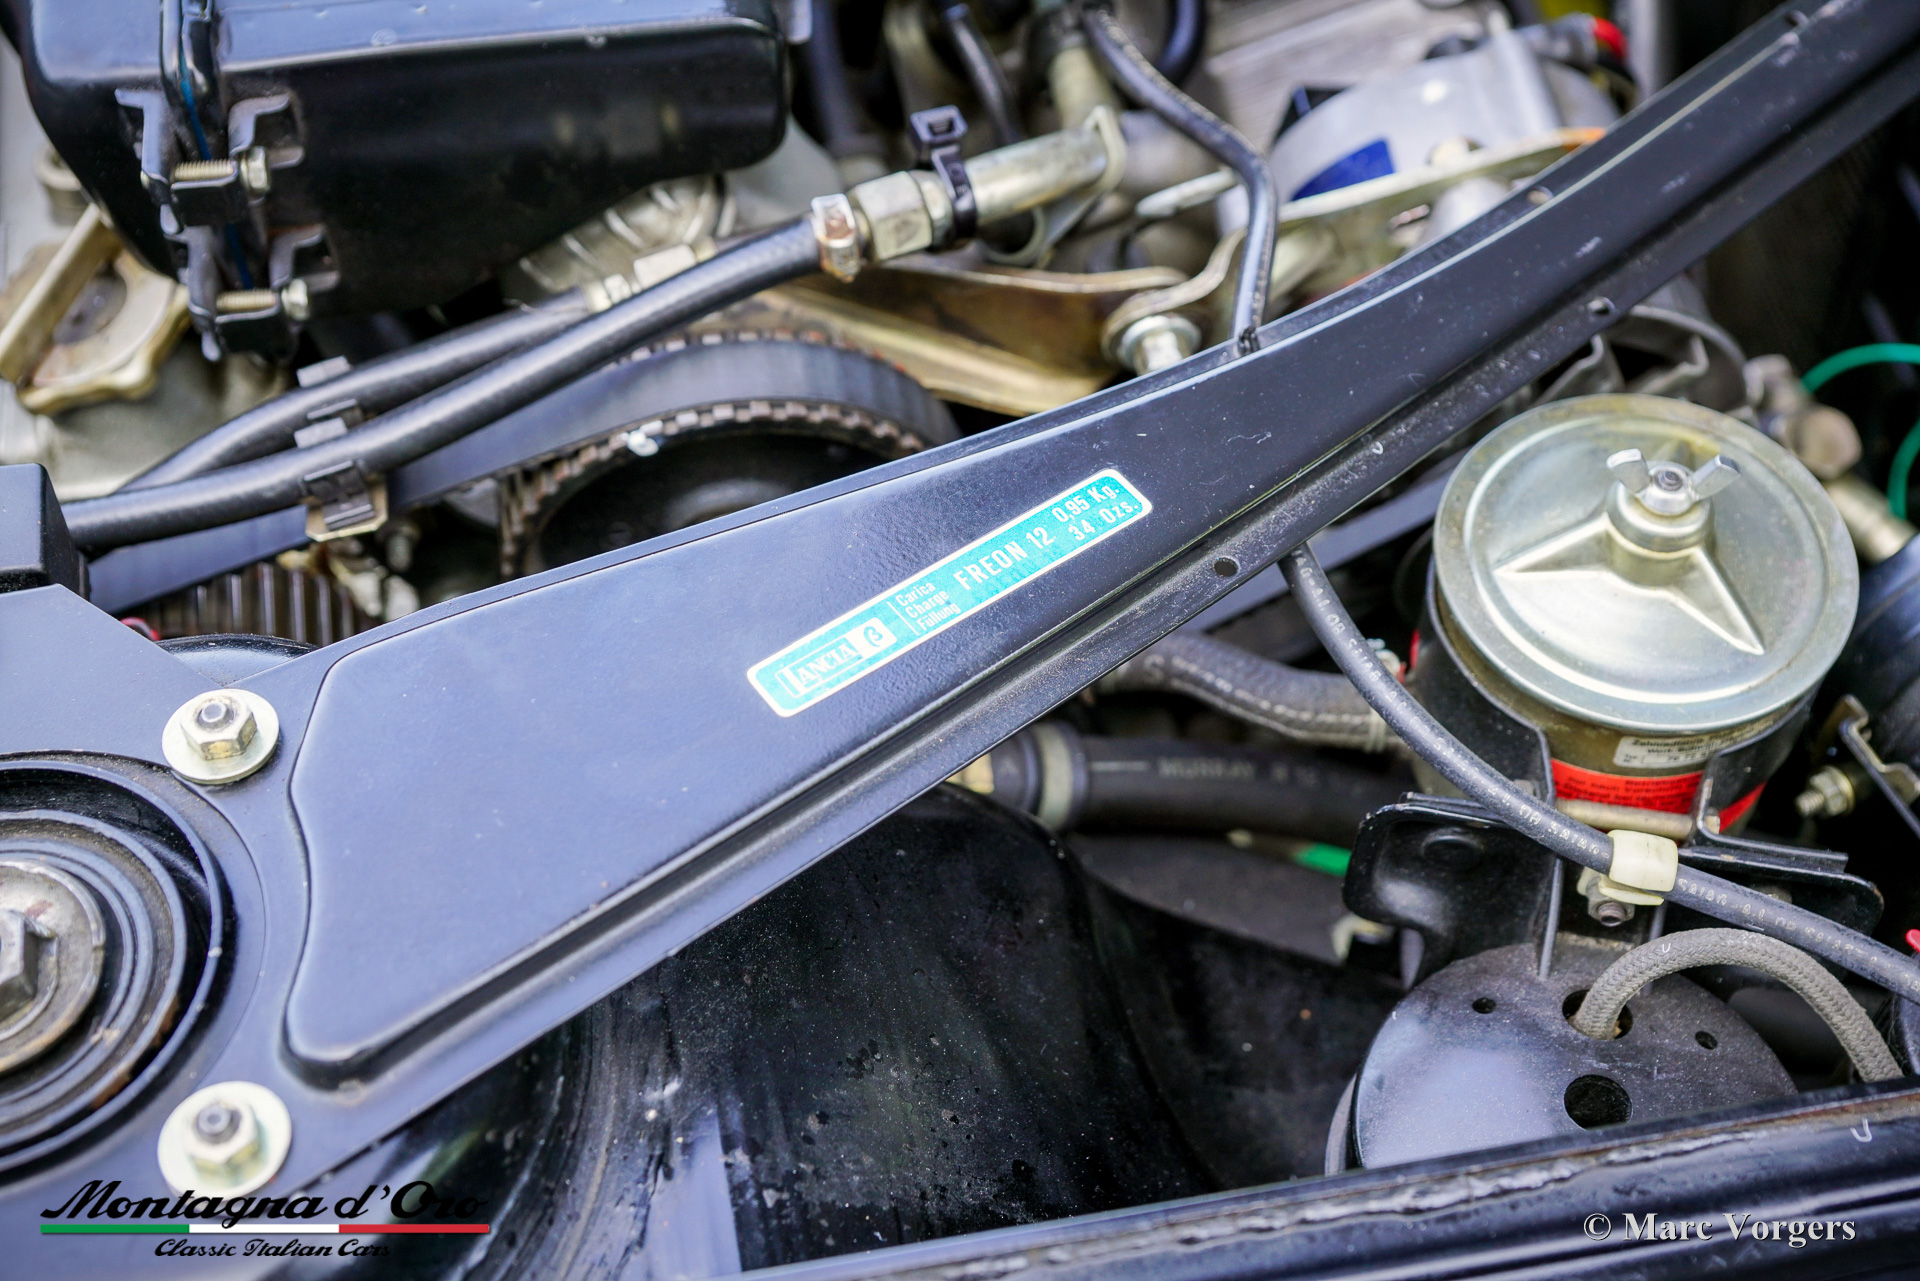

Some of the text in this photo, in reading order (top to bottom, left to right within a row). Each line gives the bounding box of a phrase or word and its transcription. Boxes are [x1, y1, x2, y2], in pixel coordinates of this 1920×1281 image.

[1052, 486, 1120, 522] 0,95 Kg.
[1068, 502, 1139, 540] 34 Ozs.
[953, 527, 1055, 590] FREON 12
[895, 582, 936, 606] Carica
[905, 590, 950, 618] Charge
[916, 603, 961, 631] Füllung
[782, 643, 859, 695] LANCIA
